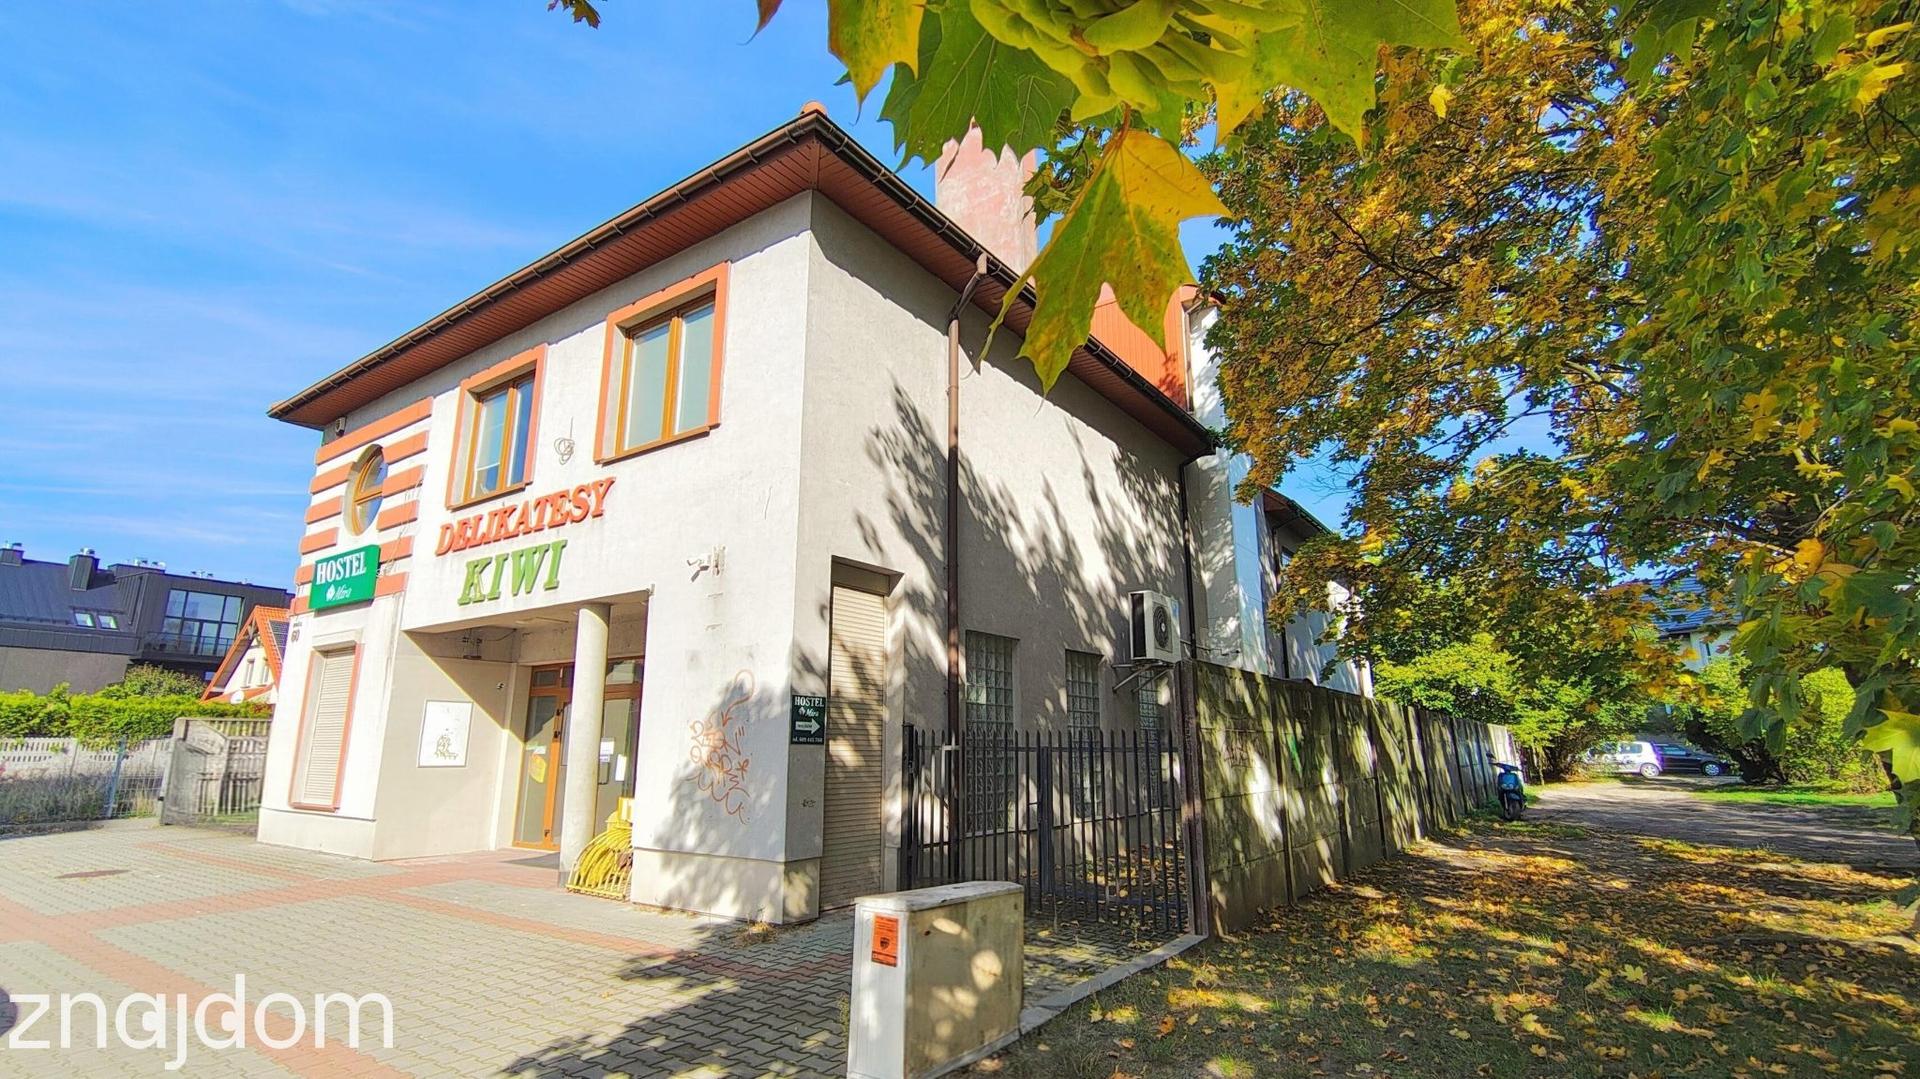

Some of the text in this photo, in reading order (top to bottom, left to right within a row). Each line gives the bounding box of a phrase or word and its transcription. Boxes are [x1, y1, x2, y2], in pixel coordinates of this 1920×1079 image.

[434, 476, 616, 556] DELIKATESY
[315, 551, 367, 585] HOSTEL
[457, 539, 568, 606] KIWI
[794, 696, 824, 708] HOSTEL
